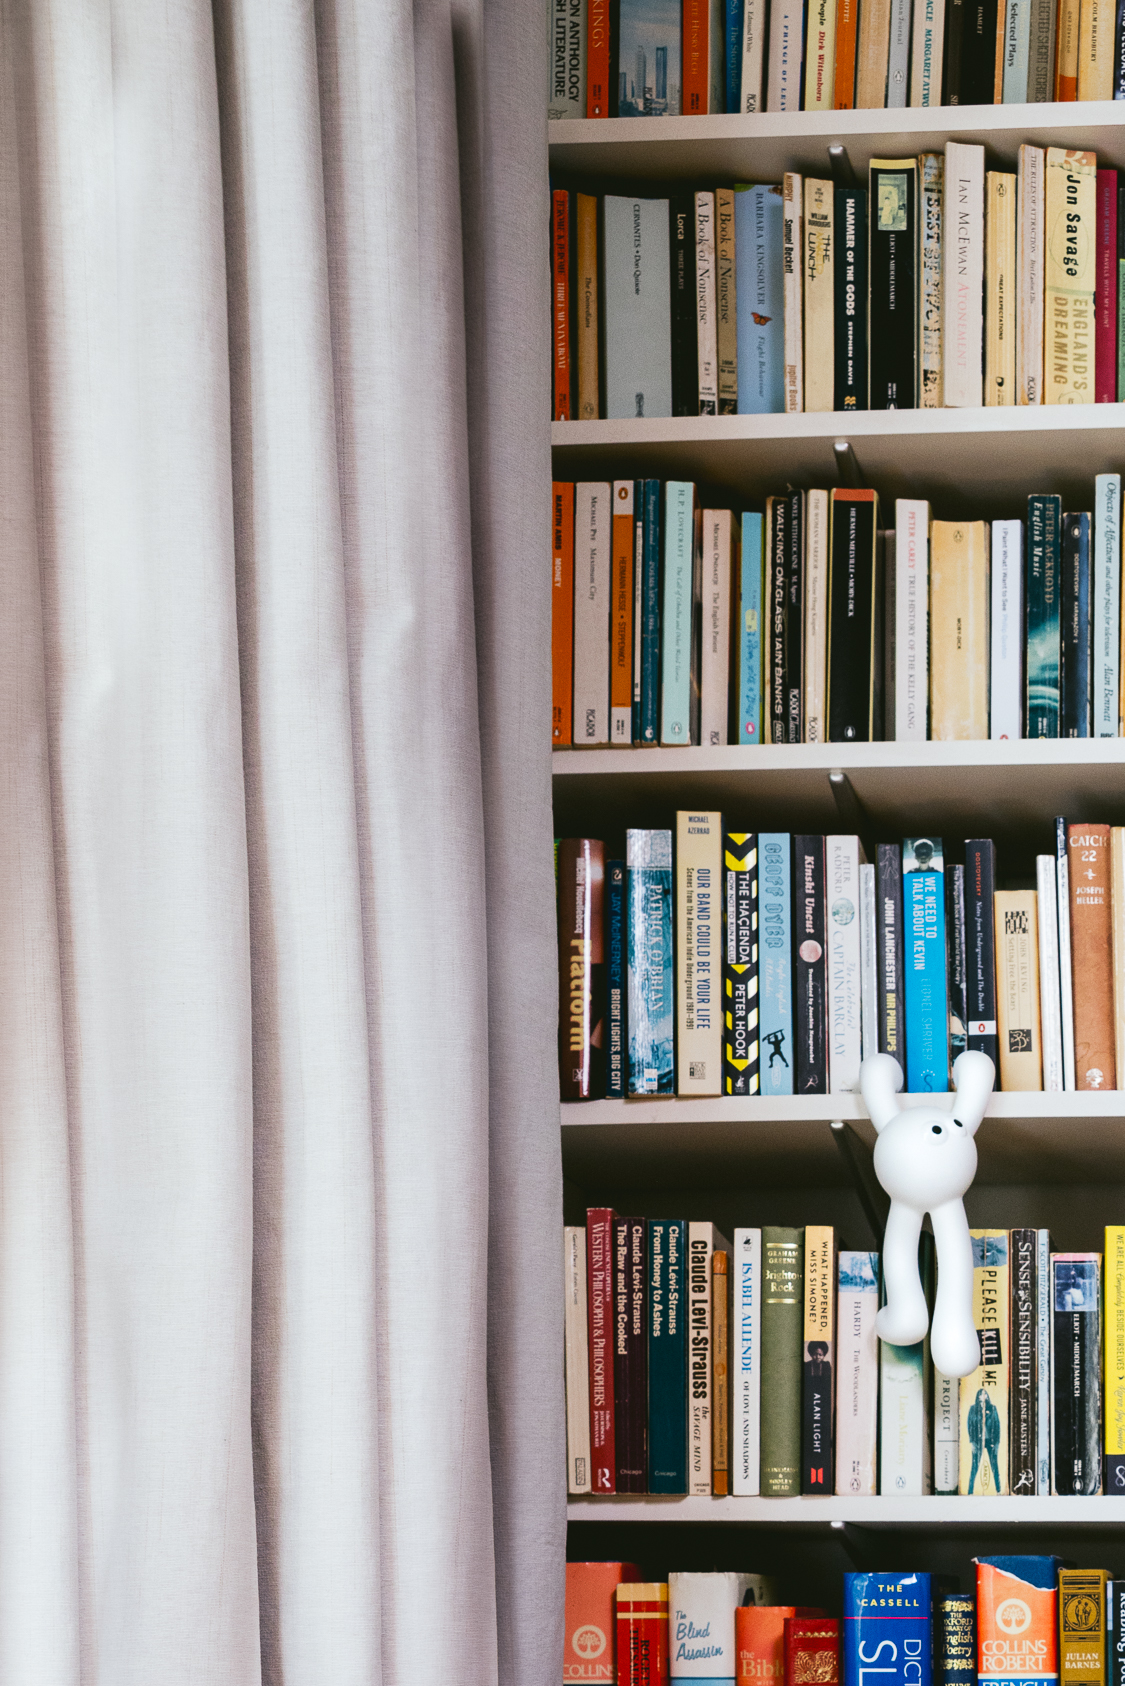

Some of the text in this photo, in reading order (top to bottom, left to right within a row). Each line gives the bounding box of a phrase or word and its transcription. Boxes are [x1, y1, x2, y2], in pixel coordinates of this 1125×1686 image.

[555, 17, 566, 97] LITERATURE
[569, 21, 579, 102] ANTHOLOGY
[816, 54, 825, 102] Wittenborn
[677, 213, 687, 240] Lorca
[719, 197, 732, 324] A Book of Nonsense
[846, 199, 856, 316] HAMMER OF THE GODS
[1063, 174, 1081, 277] Jon Savage
[1053, 296, 1069, 385] DREAMING
[1072, 299, 1088, 390] ENGLAND'S
[775, 504, 785, 563] WALKING
[1032, 502, 1043, 577] English Music
[1045, 504, 1055, 603] PETER ACKROYD
[774, 588, 784, 633] GLASS
[774, 637, 783, 664] IAIN
[774, 667, 783, 714] BANKS
[1103, 664, 1114, 722] Alan Bennett
[1081, 851, 1098, 862] 22
[737, 873, 750, 963] THE HAÇIENDA
[884, 897, 896, 990] JOHN LANCHESTER
[912, 877, 925, 970] TALK ABOUT KEVIN
[925, 877, 937, 939] WE NEED TO
[696, 868, 711, 1029] OUR BAND COULD BE YOUR LIFE
[569, 938, 592, 1051] Platform
[735, 984, 746, 1057] PETER HOOK
[610, 988, 621, 1090] BRIGHT LIGHTS, BIG CITY
[650, 1226, 663, 1338] From Honey to Ashes
[667, 1225, 679, 1335] Claude Lévi-Strauss
[809, 1250, 818, 1323] MISS SIMONE?
[818, 1241, 829, 1332] WHAT HAPPENED,
[691, 1240, 709, 1399] Claude Lévi-Strauss
[741, 1263, 752, 1375] ISABEL ALLENDE
[982, 1270, 998, 1387] PLEASE KILL ME
[812, 1393, 821, 1453] ALAN LIGHT
[861, 1599, 920, 1607] CASSELL
[878, 1584, 903, 1593] THE
[676, 1622, 711, 1641] Blind
[676, 1643, 723, 1661] Assassin
[981, 1640, 1047, 1655] COLLINS
[981, 1655, 1047, 1671] ROBERT
[1065, 1661, 1100, 1669] BARNES
[1066, 1653, 1099, 1661] JULIAN
